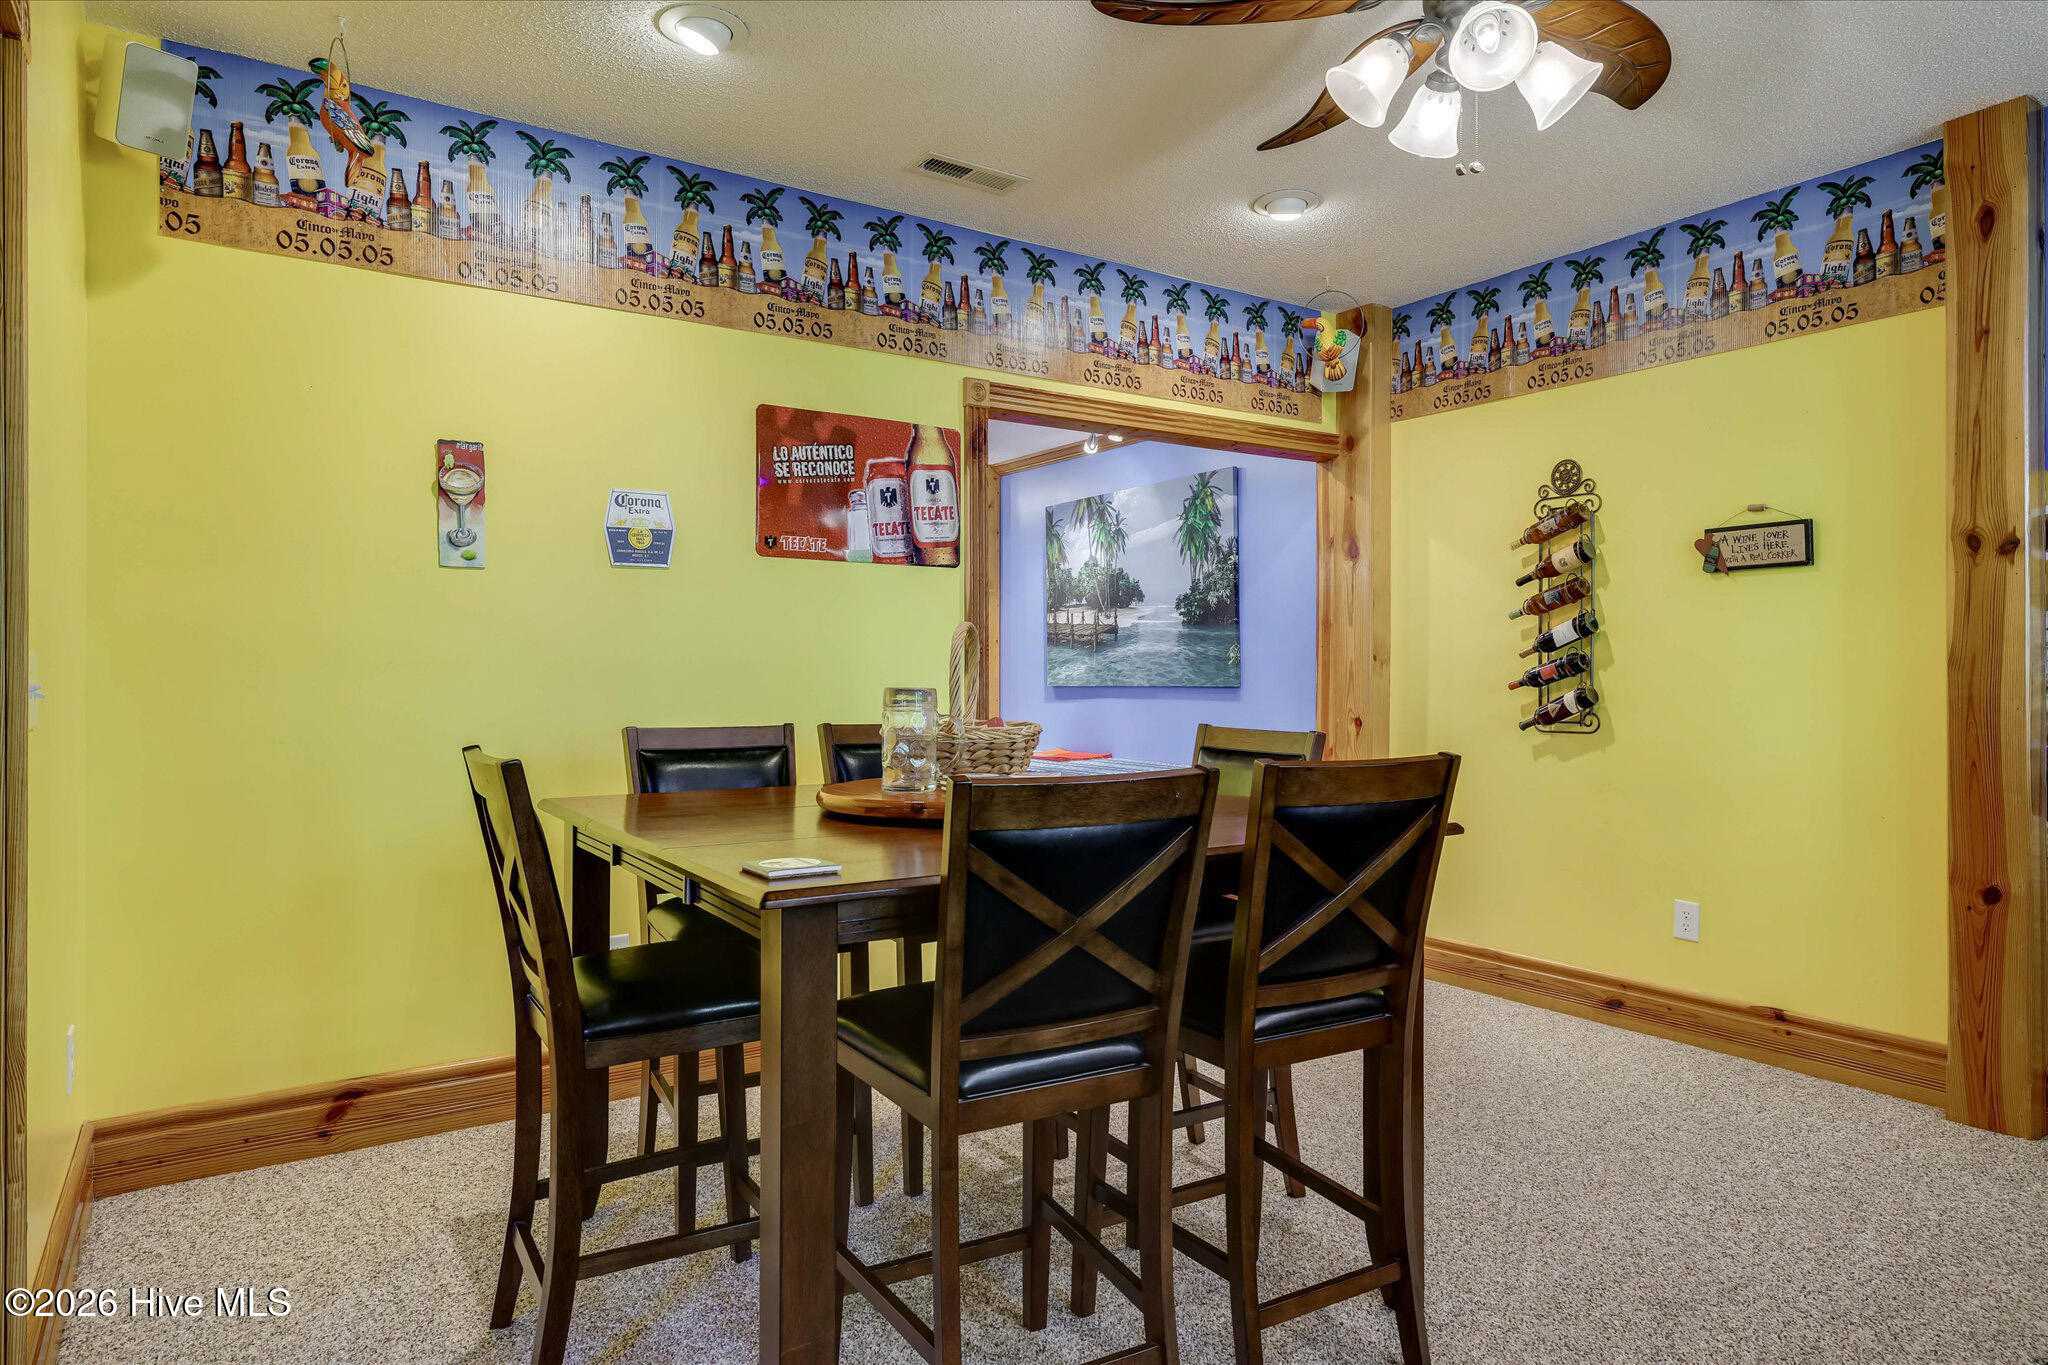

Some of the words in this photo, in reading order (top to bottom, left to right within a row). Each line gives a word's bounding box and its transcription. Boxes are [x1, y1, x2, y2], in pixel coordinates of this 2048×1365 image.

[289, 156, 319, 168] Corona
[358, 169, 385, 186] orona
[352, 189, 379, 207] Light
[296, 218, 332, 234] Cinco
[340, 227, 375, 241] Mayo
[624, 223, 648, 233] Corona
[276, 230, 394, 265] 05.05.05
[673, 232, 698, 248] Corona
[1825, 243, 1853, 254] Corona
[672, 251, 693, 266] Light
[1775, 254, 1799, 268] Corona
[458, 260, 559, 293] 05.05.05
[1823, 263, 1847, 275] Light
[631, 278, 656, 290] Cinco
[663, 284, 690, 297] Mayo
[802, 275, 823, 290] Light
[615, 288, 705, 318] 05.05.05
[767, 302, 791, 314] Cinco
[795, 308, 820, 320] Mayo
[921, 299, 938, 312] Light
[1780, 305, 1807, 317] Cinco
[1812, 296, 1842, 310] Mayo
[754, 312, 833, 339] 05.05.05
[889, 323, 910, 335] Cinco
[1765, 302, 1859, 338] 05.05.05
[877, 332, 948, 358] 05.05.05
[1637, 335, 1716, 366] 05.05.05
[985, 351, 1049, 375] 05.05.05
[1083, 368, 1142, 390] 05.05.05
[1527, 362, 1594, 389] 05.05.05
[1171, 383, 1224, 404] 05.05.05
[1433, 385, 1491, 409] 05.05.05
[1251, 397, 1299, 416] 05.05.05
[773, 446, 788, 461] LO
[792, 442, 854, 461] AUTÉNTICO
[774, 462, 790, 477] SE
[792, 460, 856, 477] RECONOCE
[614, 493, 662, 510] Corona
[628, 507, 650, 515] Extra
[913, 505, 955, 521] TECATE
[872, 521, 911, 537] TECATE
[1721, 534, 1729, 546] A
[1732, 533, 1757, 544] WINE
[1763, 530, 1790, 541] LOVER
[780, 535, 828, 553] TECATE
[1731, 543, 1759, 554] LIVES
[1767, 549, 1798, 560] CORKER
